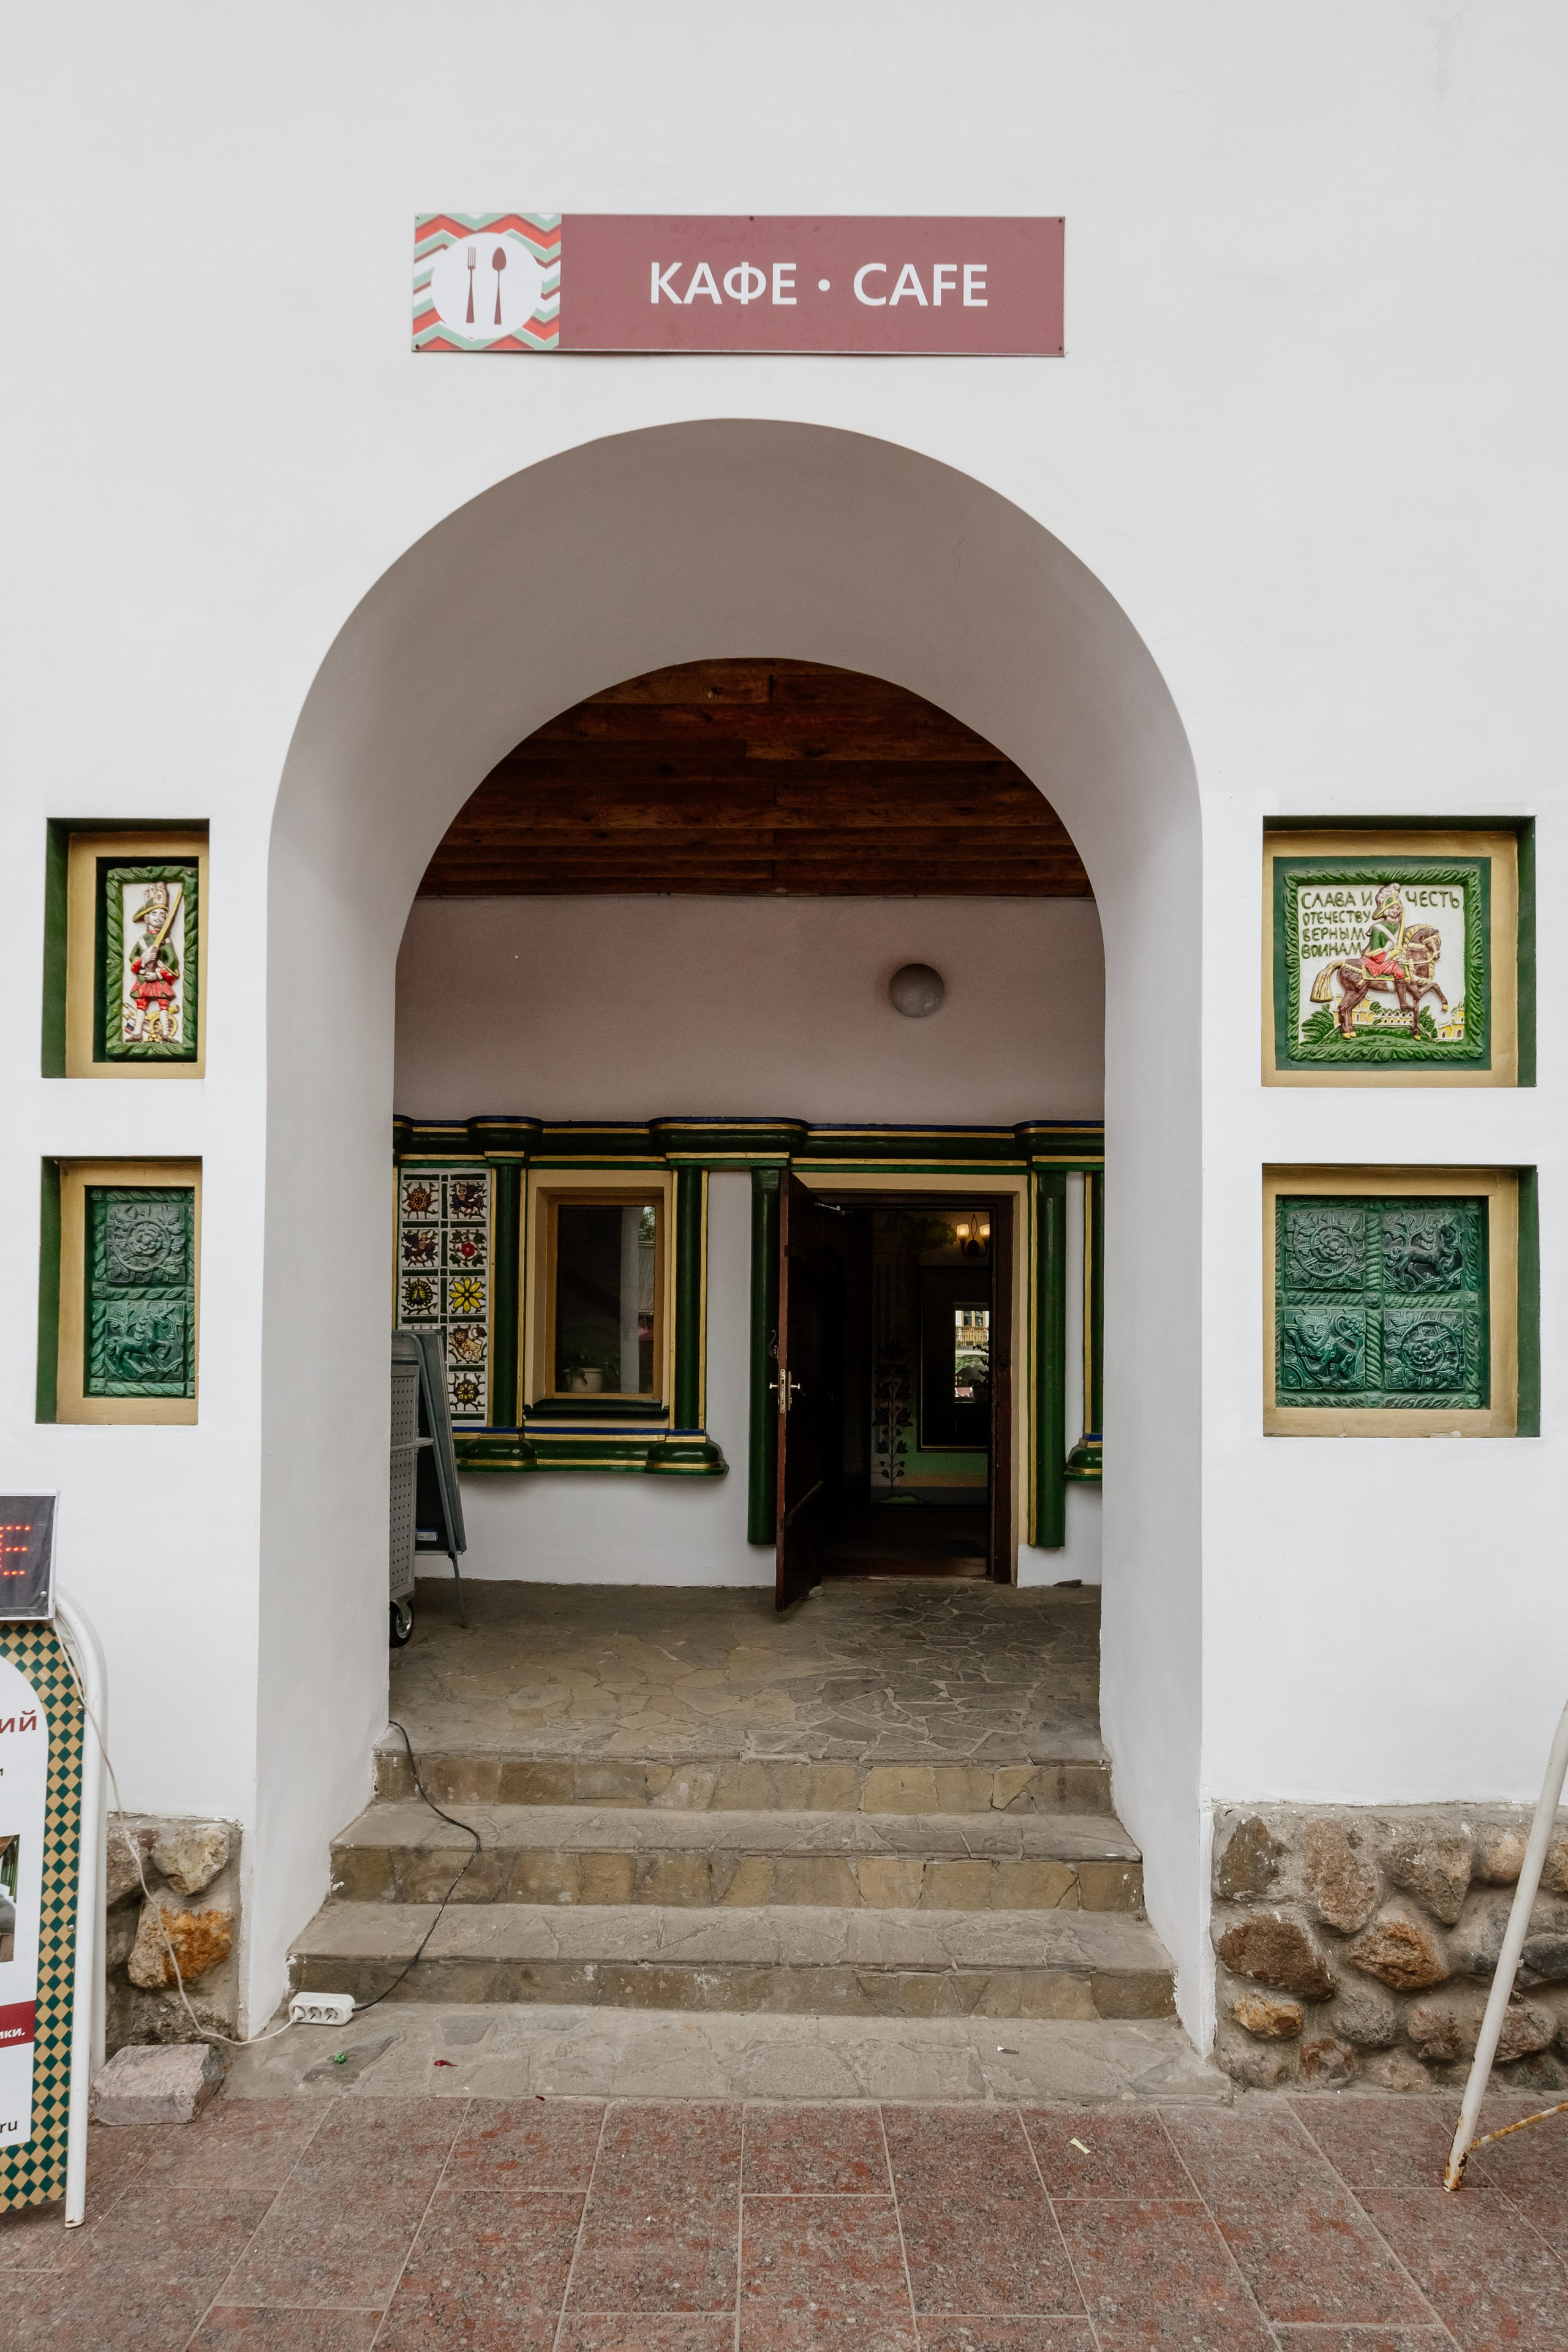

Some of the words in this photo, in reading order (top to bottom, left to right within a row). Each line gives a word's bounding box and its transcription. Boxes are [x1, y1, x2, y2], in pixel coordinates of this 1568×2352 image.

[650, 262, 797, 305] КАФЕ
[853, 263, 988, 306] CAFE
[1301, 891, 1356, 910] СЛАВА
[1361, 891, 1373, 907] И
[1405, 890, 1460, 909] ЧЕСТЬ
[1302, 910, 1371, 926] ОТЕЧЕСТВУ
[1302, 927, 1365, 942] ВЕРНЫМ
[1301, 942, 1363, 959] ВОИНАМ
